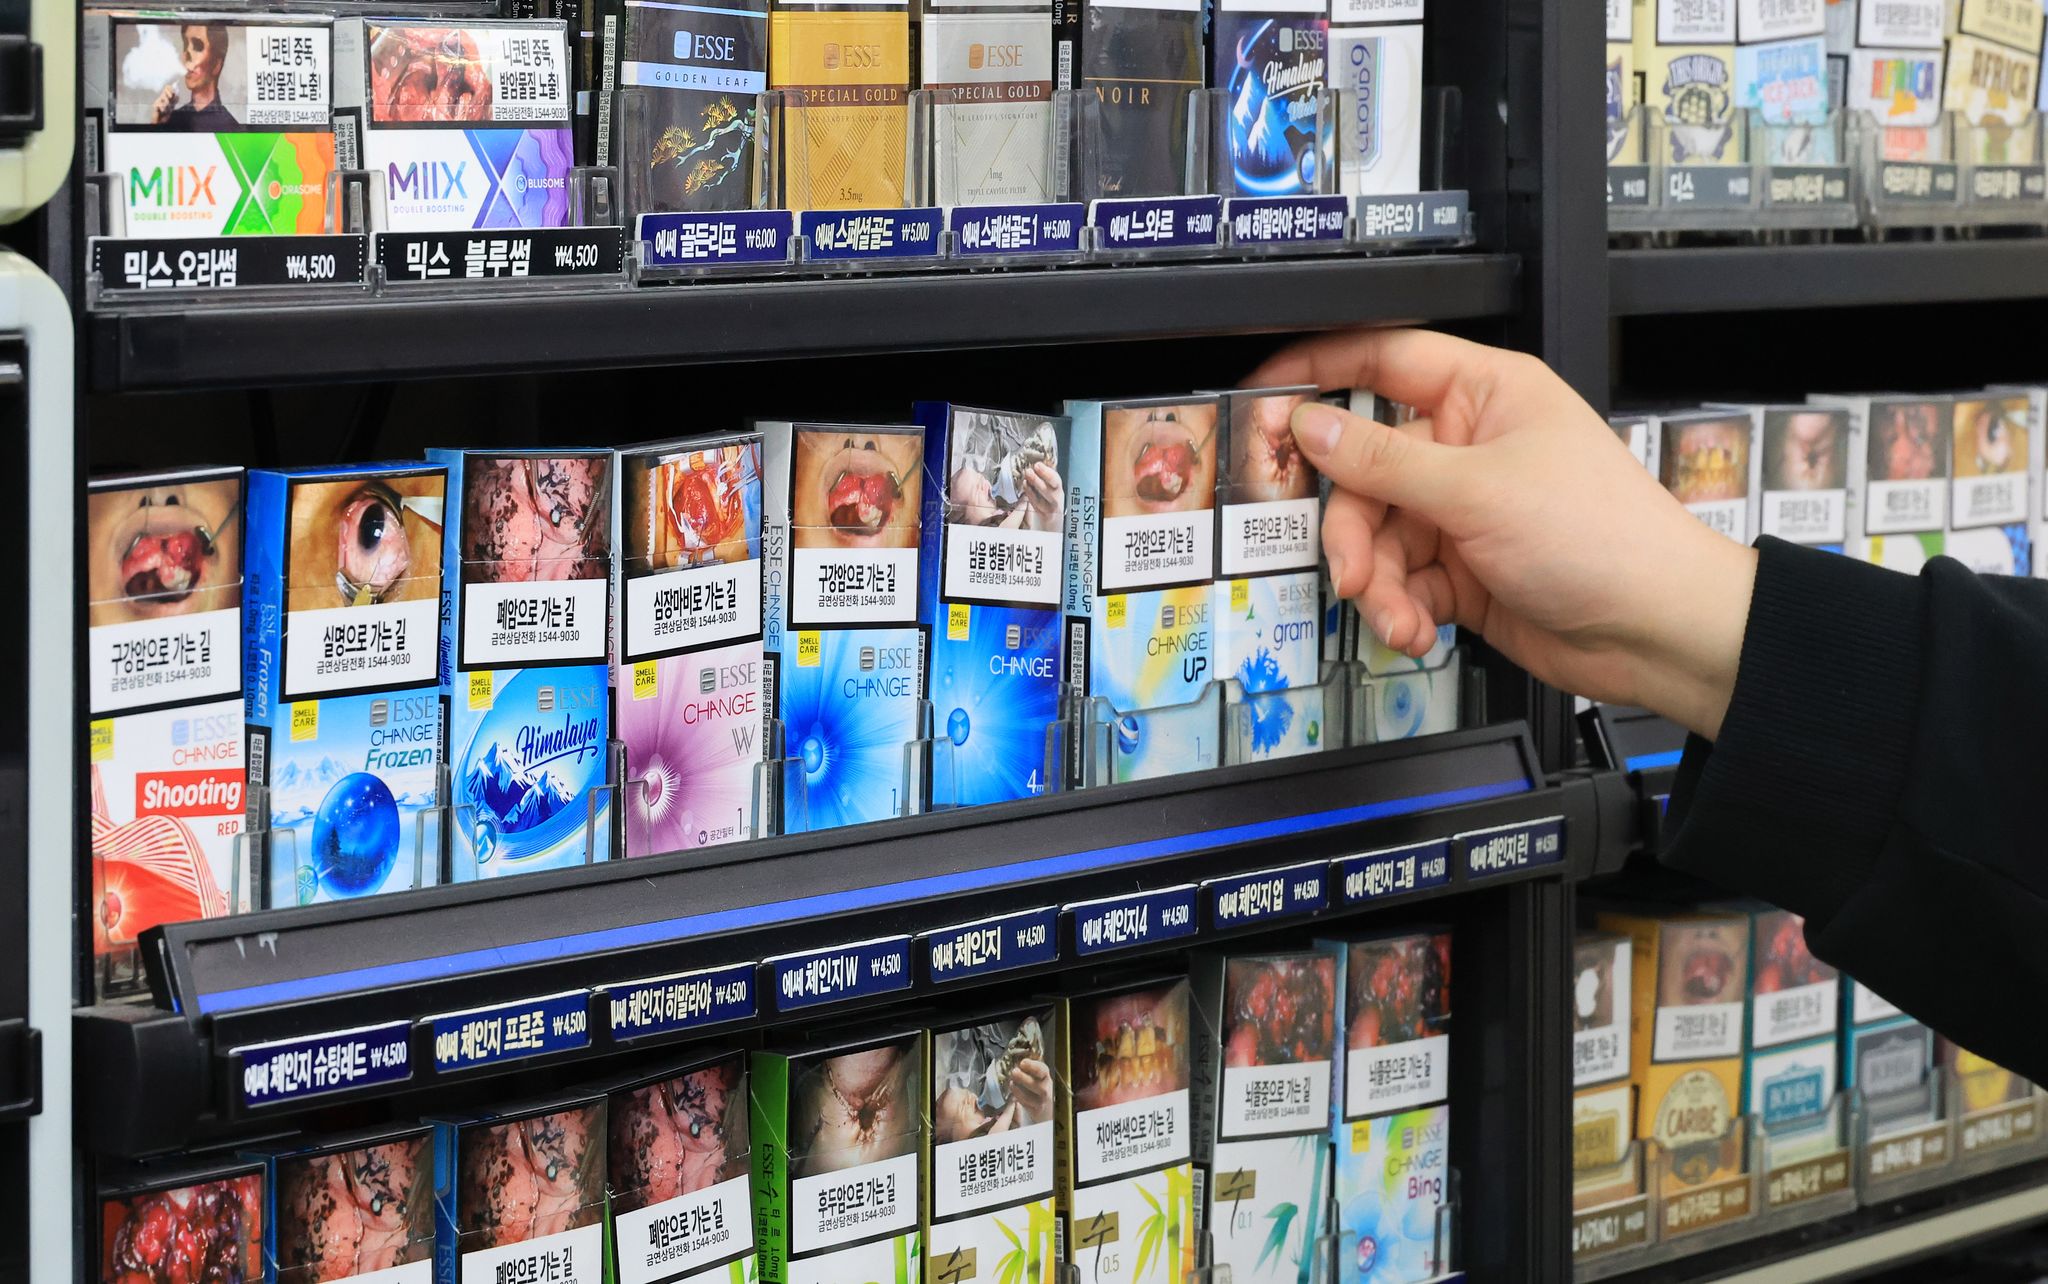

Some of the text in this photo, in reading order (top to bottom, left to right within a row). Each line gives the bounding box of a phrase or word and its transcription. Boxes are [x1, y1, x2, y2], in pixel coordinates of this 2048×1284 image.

[261, 36, 317, 70] 니코틴 중독,
[694, 34, 735, 61] ESSE
[987, 45, 1023, 68] ESSE
[256, 72, 322, 101] 발암물질 노출!
[500, 72, 560, 100] 발암물질 노출!
[656, 70, 749, 87] GOLDEN LEAF
[951, 85, 1041, 100] SPECIAL GOLD
[803, 88, 898, 103] SPECIAL GOLD
[1096, 86, 1150, 105] NOIR
[130, 166, 217, 207] MIIX
[388, 161, 468, 201] MIIX
[528, 178, 565, 189] BLUSOME
[394, 204, 465, 214] DOUBLE BOOSTING
[1110, 209, 1213, 242] 에쎄 느와르 ₩5,000
[1235, 206, 1343, 240] 에쎄 히말라야 윈터 ₩4,500
[655, 221, 776, 258] 에쎄 골든리프 ₩6,000
[815, 216, 930, 251] 에쎄 스페셜골드 ₩5,000
[962, 221, 980, 248] 에쎄
[1043, 219, 1071, 239] ₩5,000
[286, 255, 336, 282] ₩4,500
[406, 239, 599, 280] 믹스 블루썸 ₩4,500
[1243, 512, 1308, 543] 후두암으로 가는 길
[770, 525, 783, 567] ESSE
[970, 541, 1043, 574] 남을 병들게 하는 길
[1067, 487, 1080, 611] 타르 1.0mg 니코틴 0.10mg
[818, 562, 896, 594] 구강암으로 가는 길
[496, 595, 575, 631] 폐암으로 가는 길
[653, 577, 737, 622] 심장마비로 가는 길
[768, 570, 782, 647] CHANGE
[323, 617, 406, 659] 실명으로 가는 길
[491, 630, 580, 646] 금연상담전화 1544-9030
[653, 611, 737, 636] 금연상담전화 1544-9030
[1273, 619, 1314, 651] gram
[111, 628, 211, 676] 구강암으로 가는 길
[989, 655, 1054, 678] CHANGE
[471, 677, 491, 686] SMELL
[1183, 656, 1207, 683] UP
[470, 685, 491, 696] CARE
[843, 677, 911, 698] CHANGE
[293, 717, 316, 727] CARE
[294, 709, 316, 718] SMELL
[683, 692, 756, 725] CHANGE
[516, 713, 599, 770] Himalaya
[365, 748, 432, 771] Frozen
[142, 776, 242, 811] Shooting
[217, 820, 238, 836] RED
[1345, 869, 1364, 899] 에쎄
[1364, 862, 1394, 896] 체인지
[1395, 855, 1416, 888] 그램
[1218, 889, 1238, 920] 에쎄
[1294, 878, 1320, 901] ₩4,500
[1082, 917, 1102, 947] 에쎄
[1162, 904, 1189, 927] ₩4,500
[932, 924, 1046, 972] 에쎄 체인지 ₩4,500
[782, 969, 804, 999] 에쎄
[871, 953, 901, 977] ₩4,500
[628, 989, 664, 1028] 체인지
[665, 979, 713, 1021] 히말라야
[715, 981, 746, 1005] ₩4,500
[436, 1010, 587, 1063] 에쎄 체인지 프로즌 ₩4,500
[244, 1041, 407, 1097] 에쎄 체인지 슈팅레드 ₩4,500
[1245, 1076, 1311, 1109] 뇌졸중으로 가는 길
[1096, 1106, 1175, 1148] 치아변색으로 가는 길
[959, 1139, 1035, 1184] 남을 병들게 하는 길
[818, 1173, 896, 1219] 후두암으로 가는 길
[1408, 1175, 1442, 1206] Bing
[649, 1198, 724, 1249] 폐암으로 가는 길
[1102, 1253, 1120, 1275] 0.5
